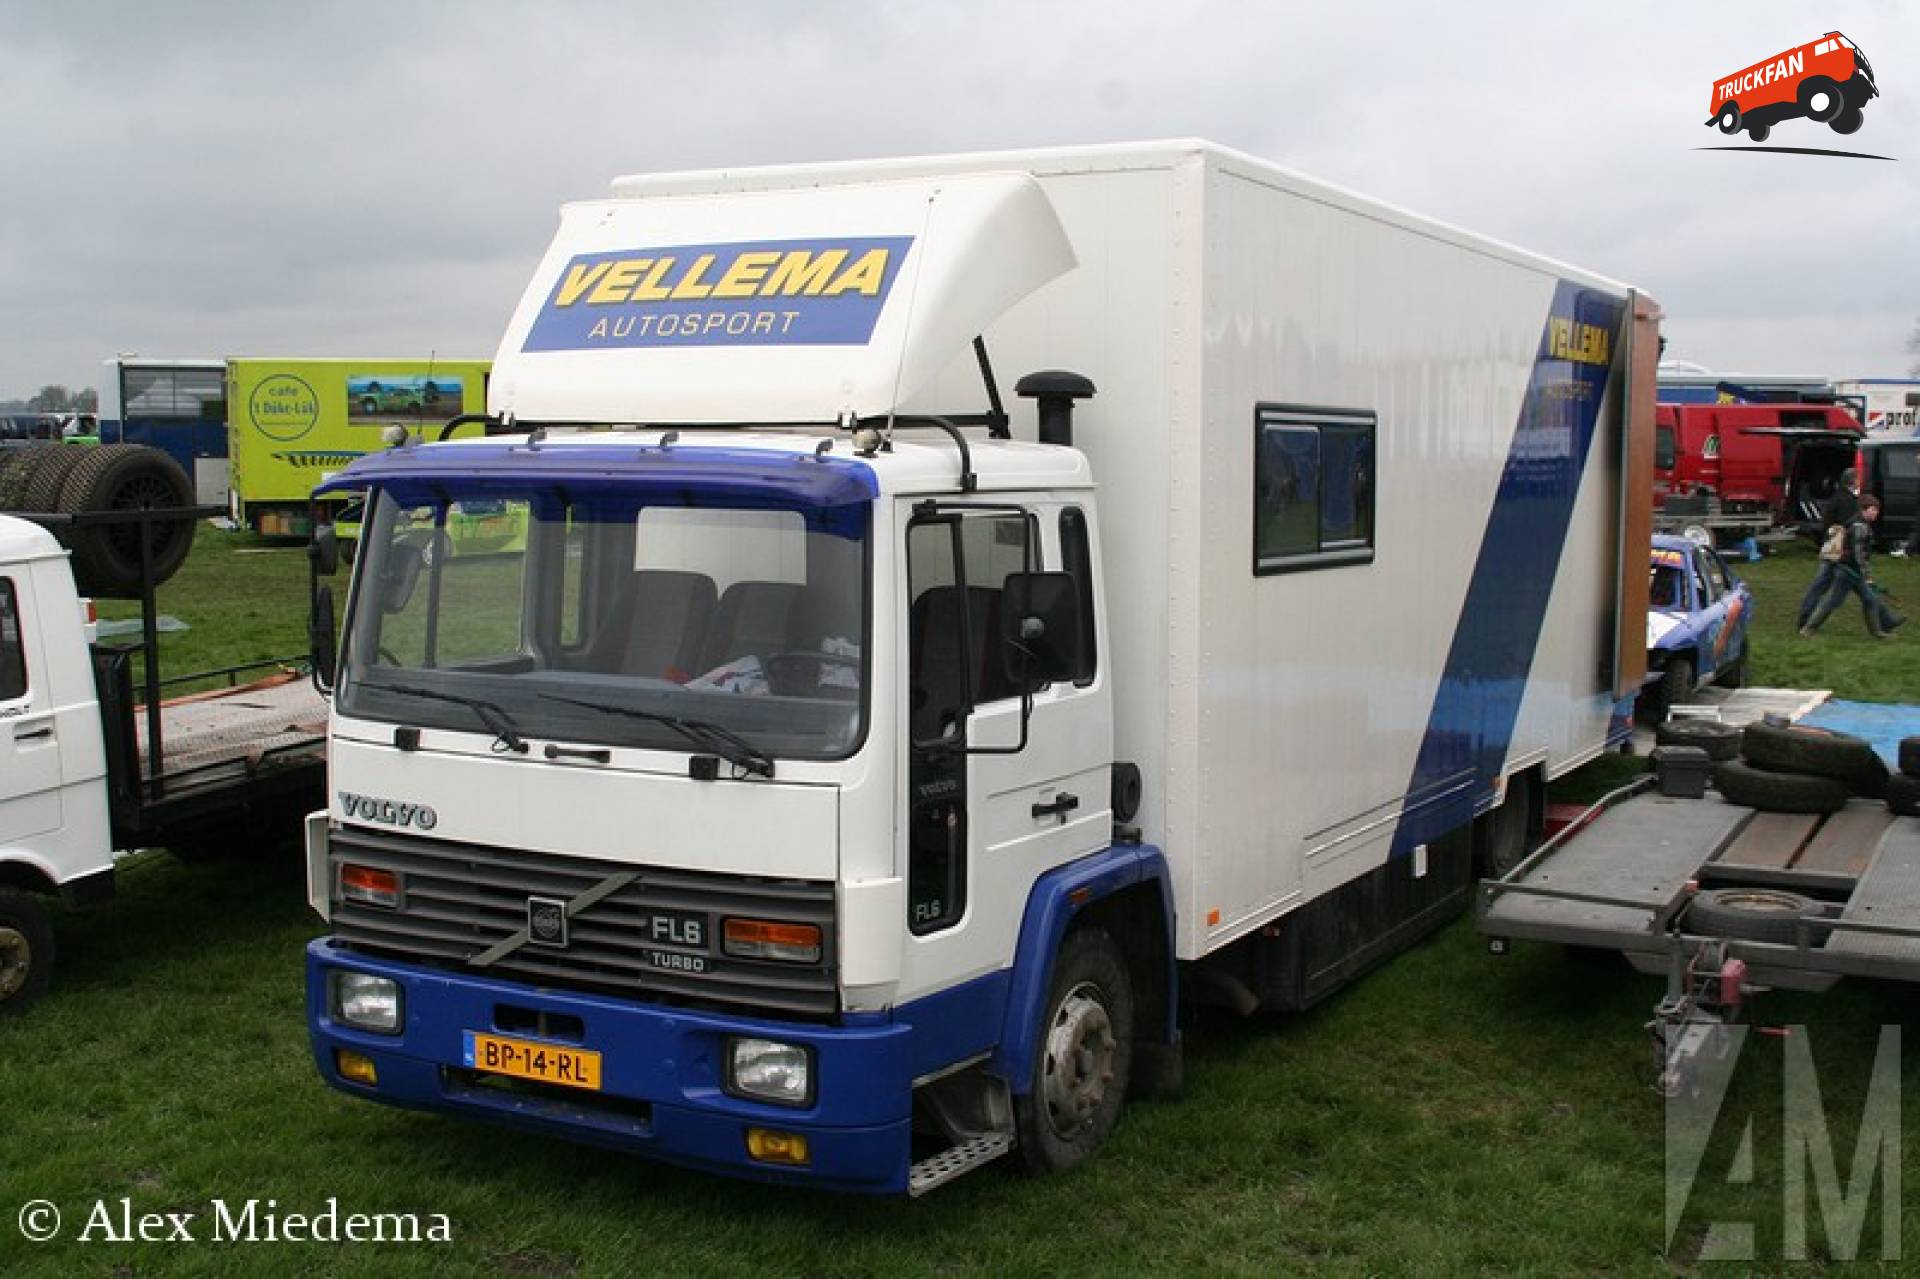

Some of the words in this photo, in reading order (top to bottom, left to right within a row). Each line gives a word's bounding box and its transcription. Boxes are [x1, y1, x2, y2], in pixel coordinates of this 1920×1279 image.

[555, 248, 889, 309] VELLEMA
[588, 311, 800, 340] AUTOSPORT
[338, 791, 437, 830] VOLVO
[915, 899, 942, 922] FL6
[652, 915, 701, 944] FL6
[652, 952, 704, 971] TURBO
[486, 1040, 589, 1083] BP-14-RL
